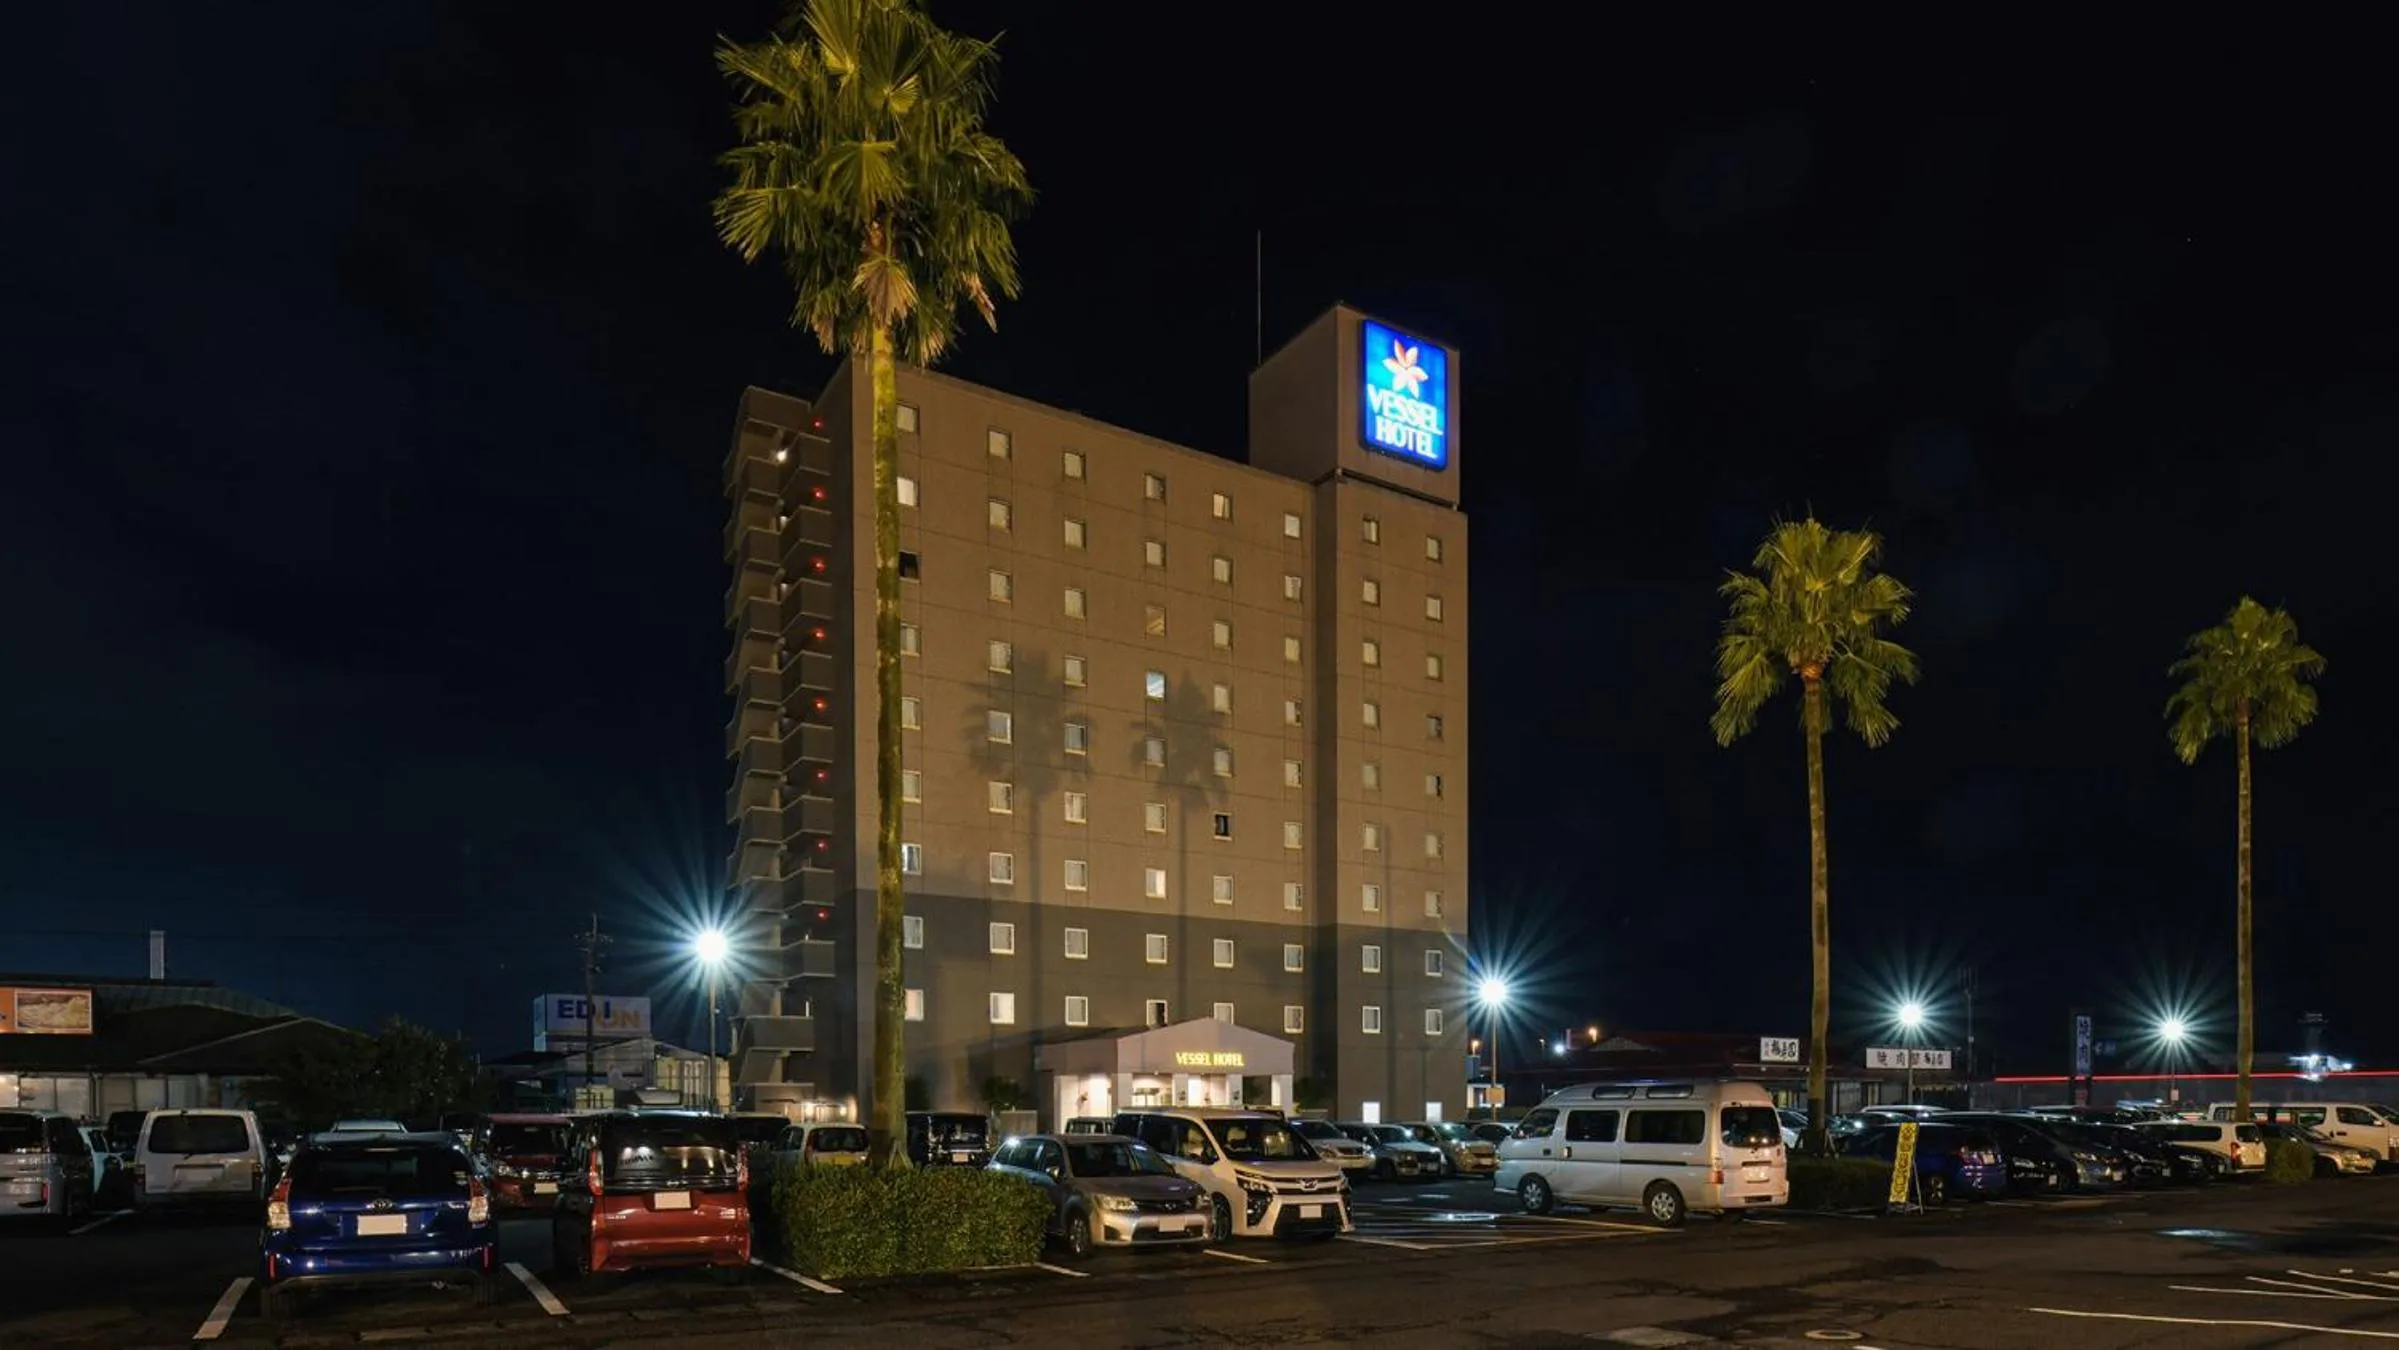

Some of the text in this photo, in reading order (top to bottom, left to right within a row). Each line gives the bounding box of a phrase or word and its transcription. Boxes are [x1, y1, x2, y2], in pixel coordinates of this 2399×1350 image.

[1366, 383, 1444, 436] VESSEL
[1375, 415, 1438, 459] HOTEL
[556, 999, 640, 1029] EDION
[1175, 1052, 1245, 1067] VESSEL HOTEL
